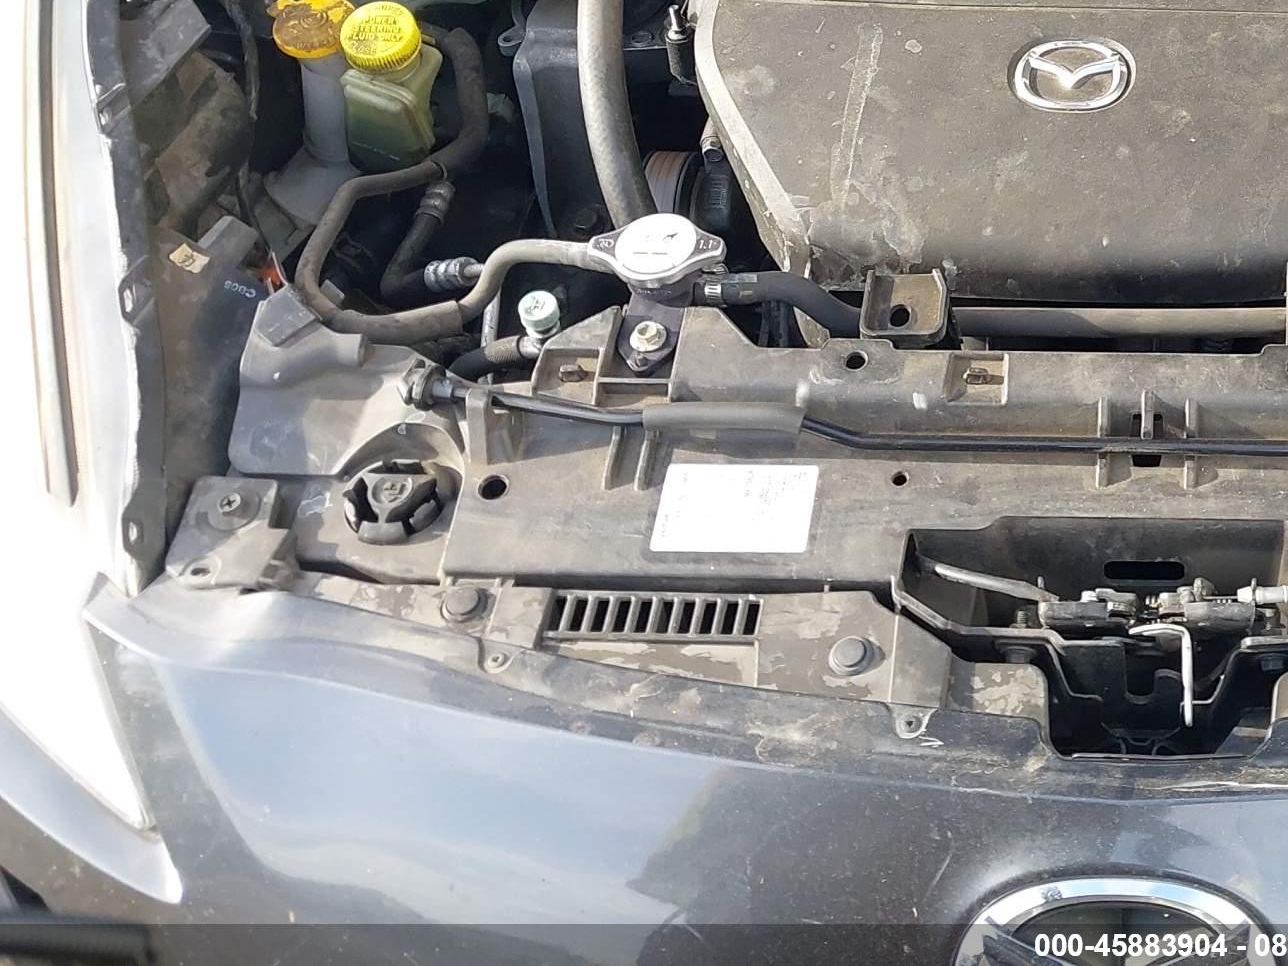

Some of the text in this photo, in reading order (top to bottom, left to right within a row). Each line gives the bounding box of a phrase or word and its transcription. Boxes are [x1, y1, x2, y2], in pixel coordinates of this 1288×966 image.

[361, 16, 398, 26] POWER
[351, 24, 402, 34] STEERING
[345, 31, 405, 43] FLUID ONLY
